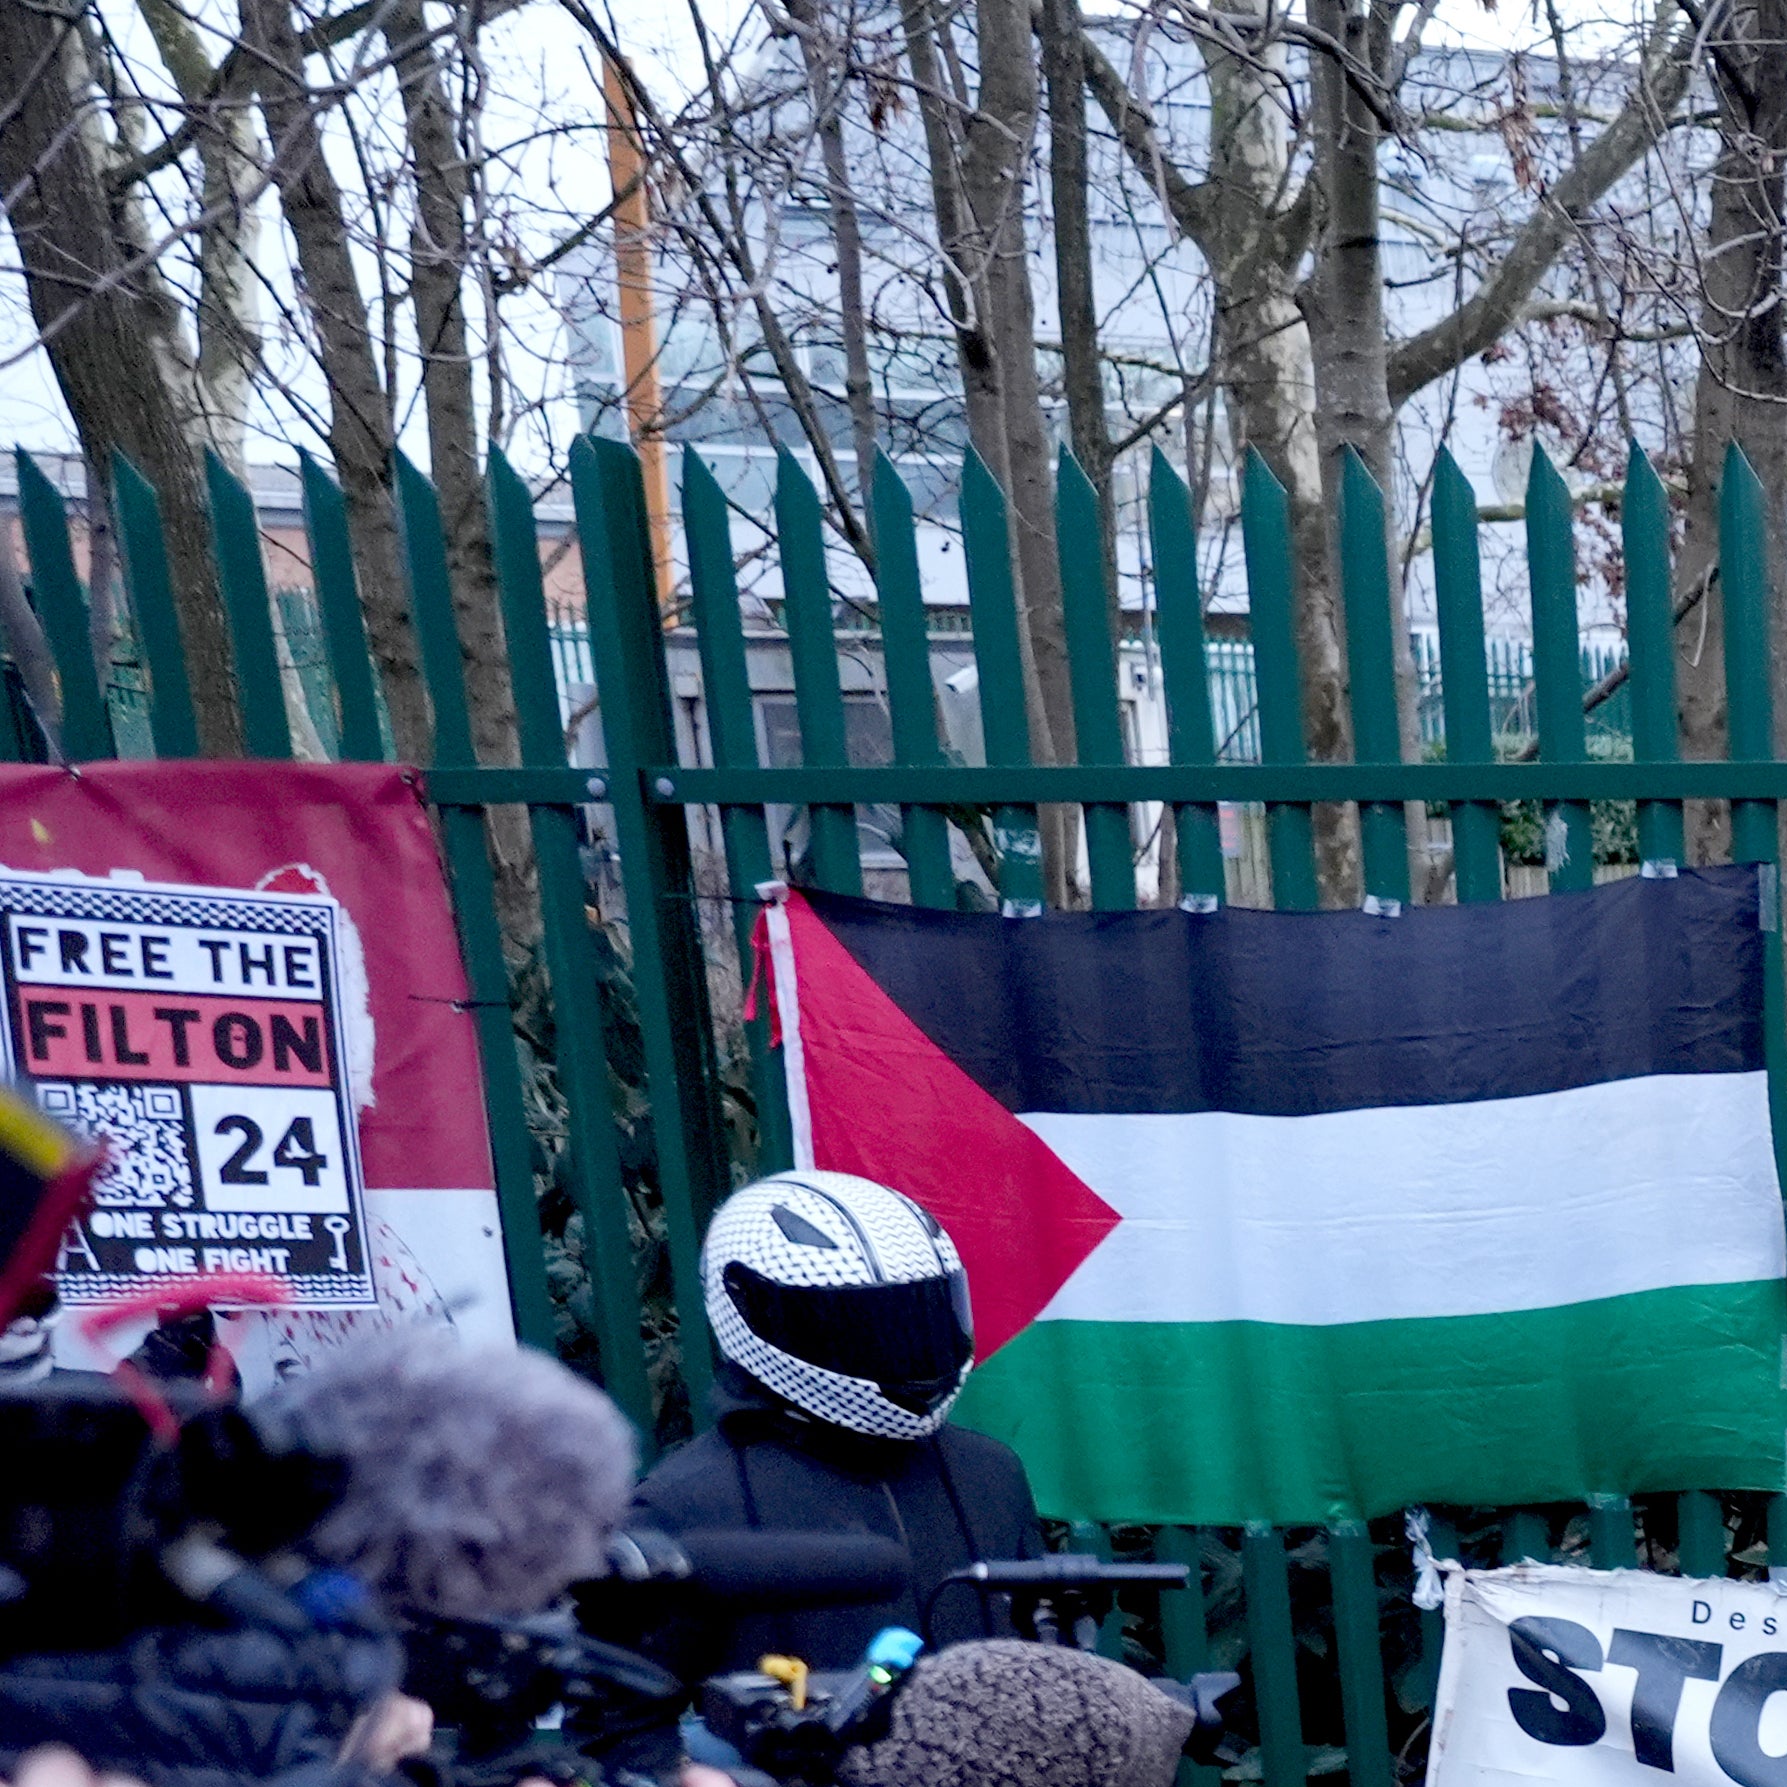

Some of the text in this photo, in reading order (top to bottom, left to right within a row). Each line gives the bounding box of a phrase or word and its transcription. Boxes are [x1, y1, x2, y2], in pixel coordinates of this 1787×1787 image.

[17, 927, 316, 989] FREE THE
[26, 1000, 324, 1074] FILTON
[213, 1114, 328, 1187] 24
[89, 1213, 314, 1241] ONE STRUGGLE
[134, 1248, 291, 1274] ONE FIGHT
